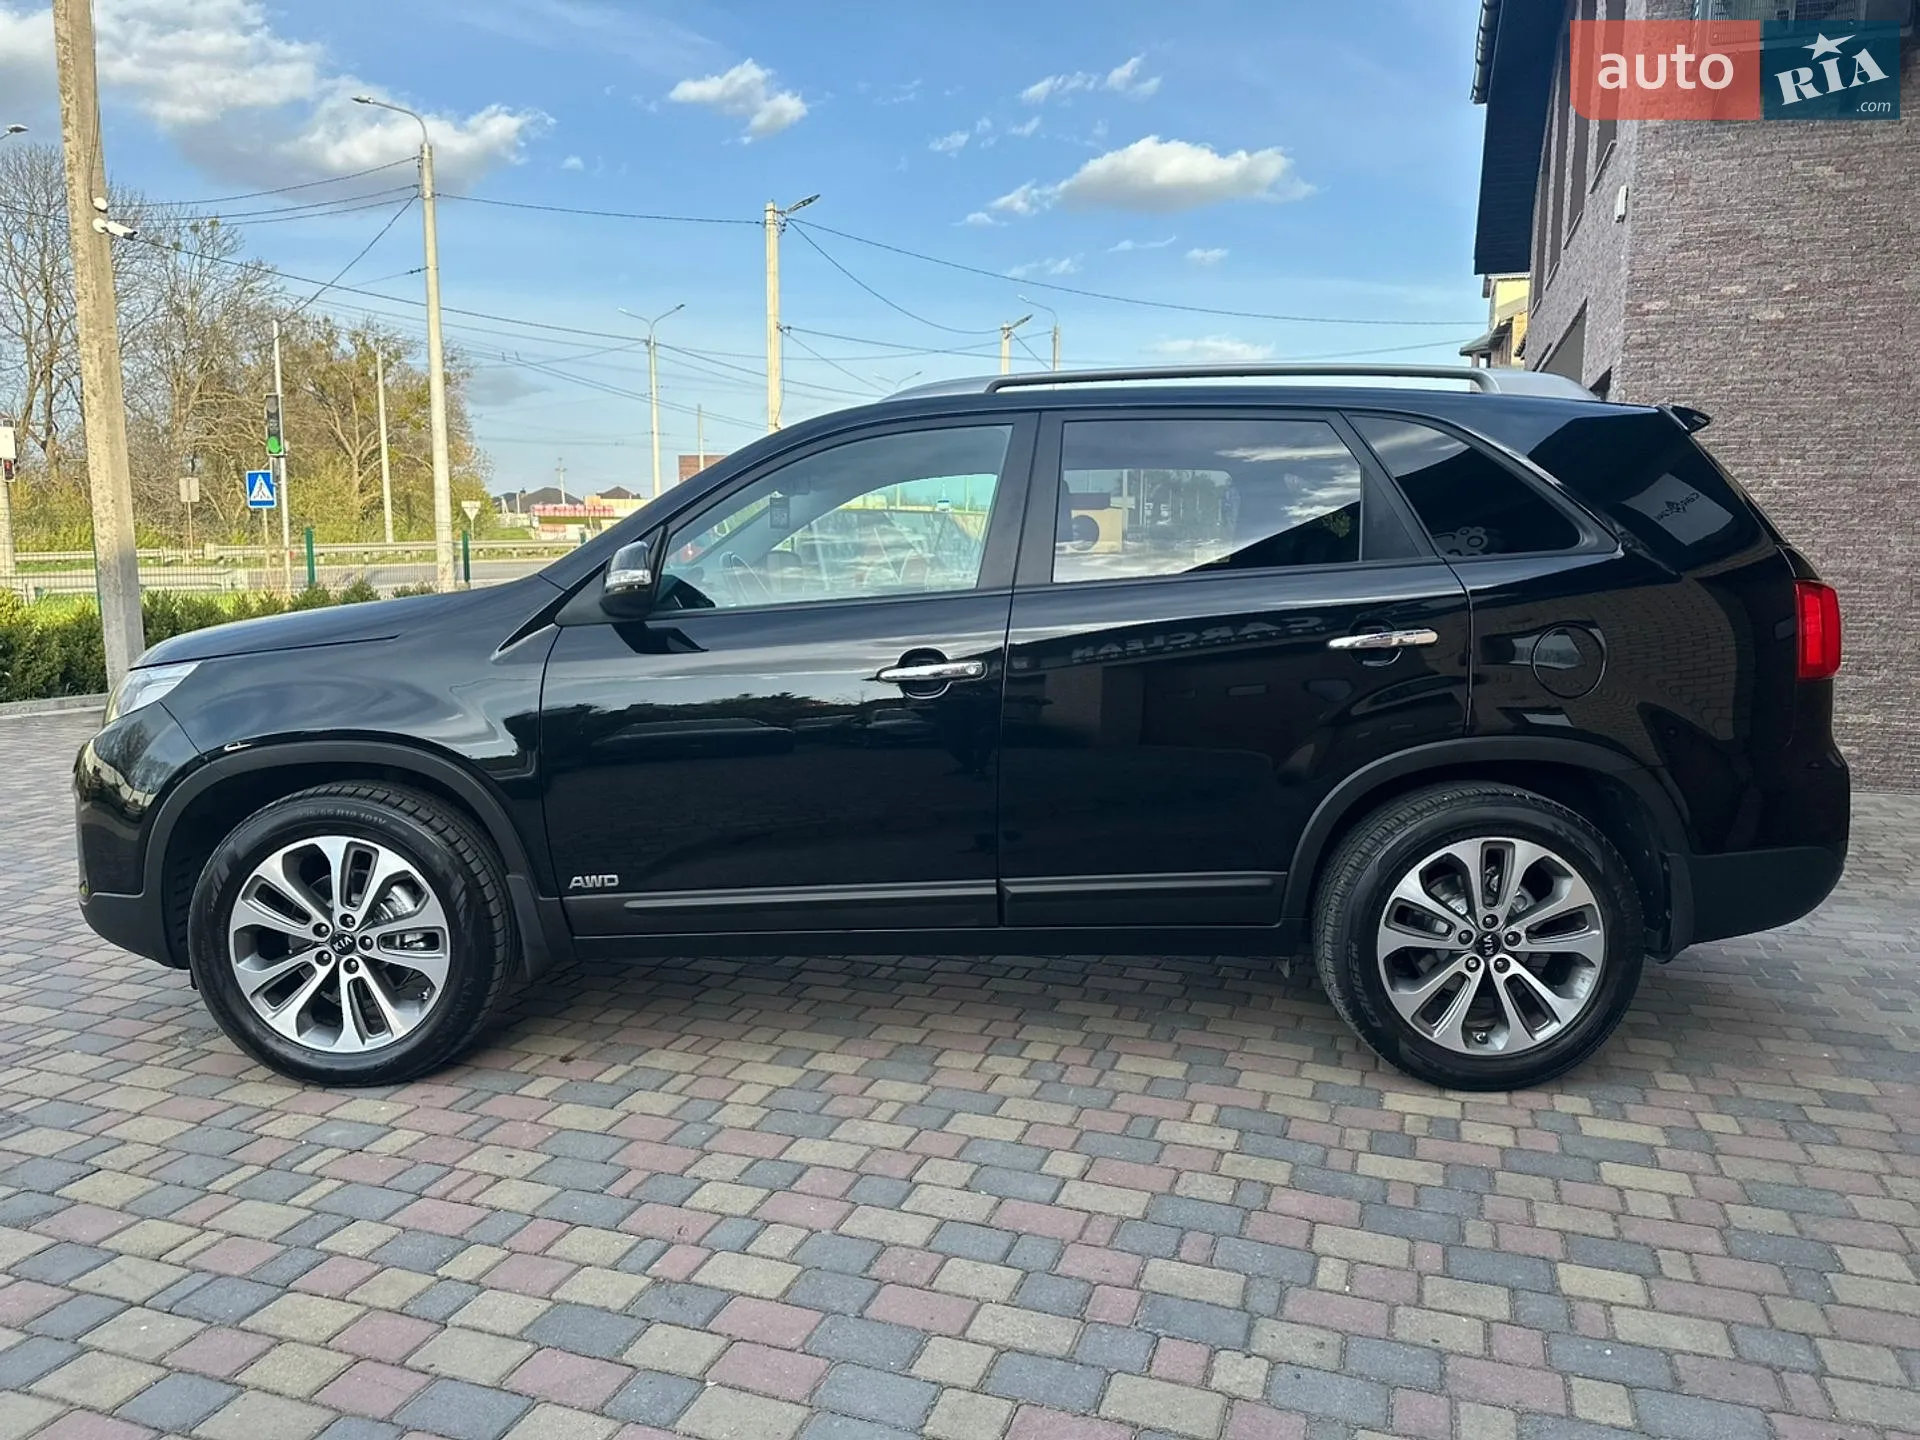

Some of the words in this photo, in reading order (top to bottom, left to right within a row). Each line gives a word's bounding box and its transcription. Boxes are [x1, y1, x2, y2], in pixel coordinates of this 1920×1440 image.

[568, 874, 619, 889] AWD
[332, 936, 353, 952] KIA
[1483, 934, 1494, 956] KIA
